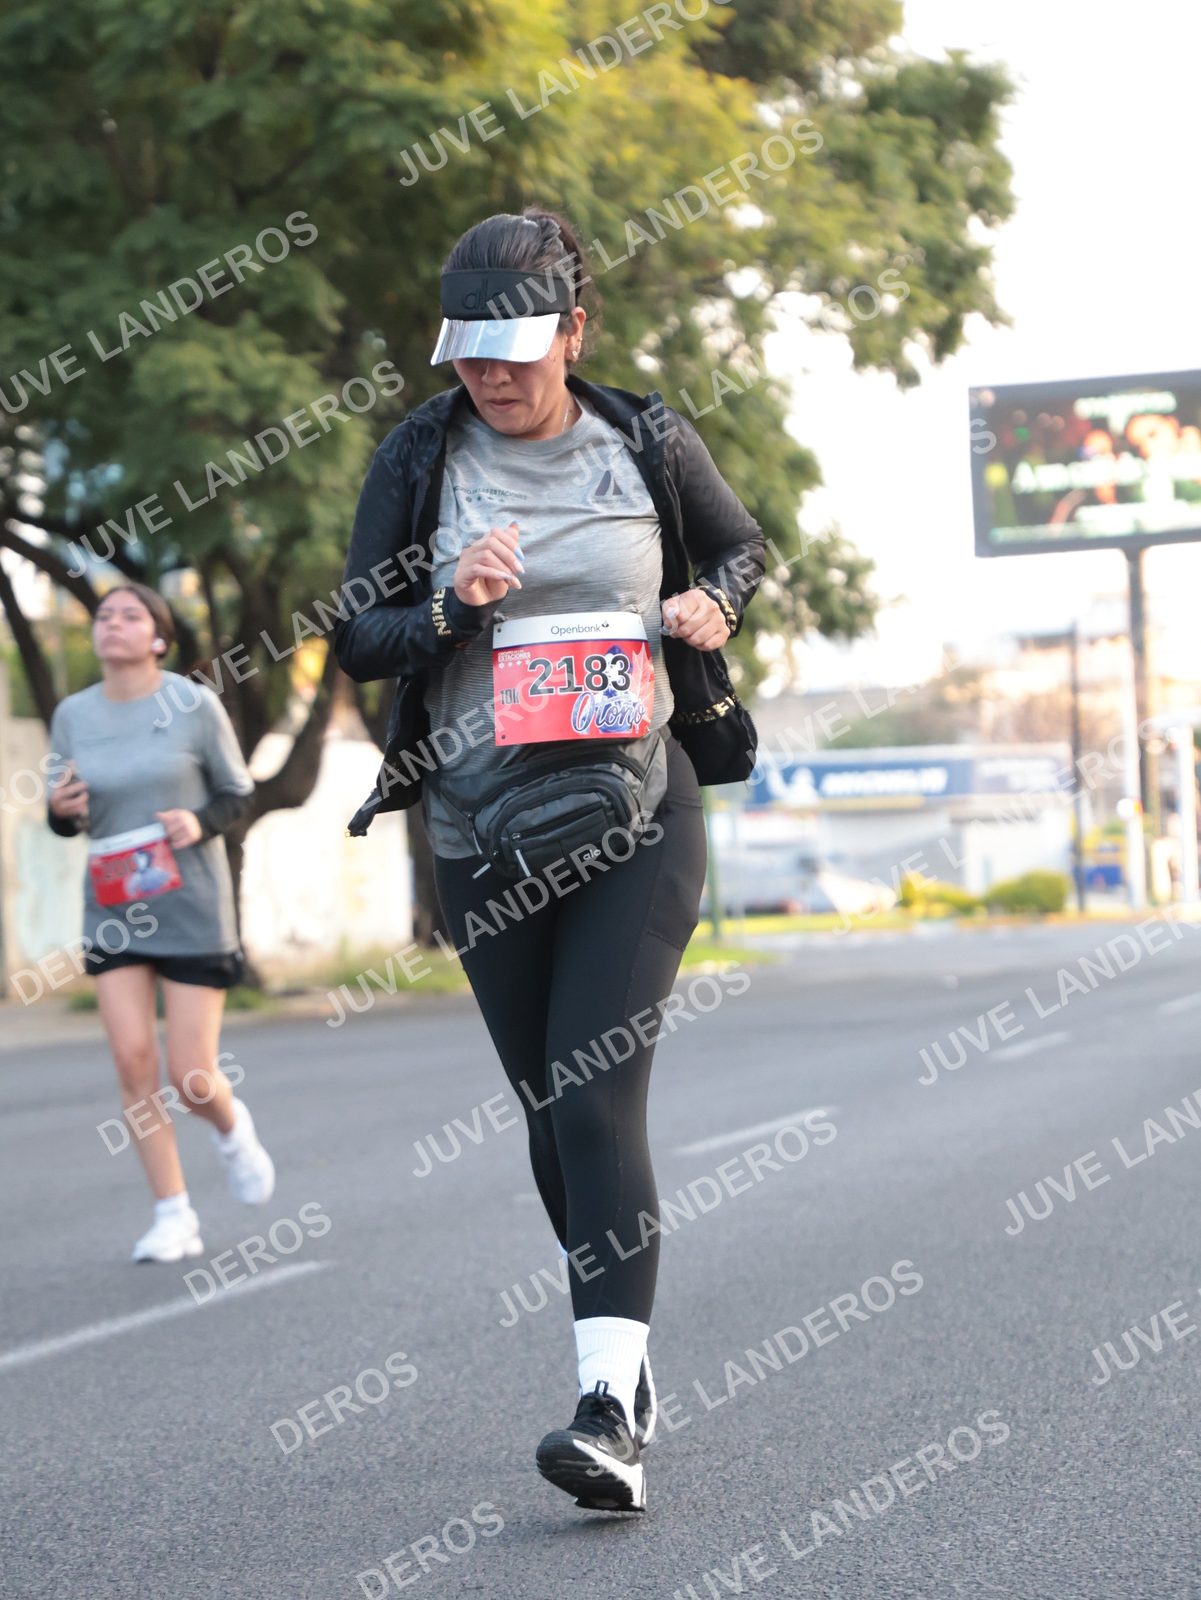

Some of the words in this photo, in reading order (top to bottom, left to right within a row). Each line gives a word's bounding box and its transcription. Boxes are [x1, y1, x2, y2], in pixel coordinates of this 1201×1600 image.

[551, 623, 601, 636] Openbank
[527, 653, 631, 697] 2183
[583, 849, 601, 861] alo
